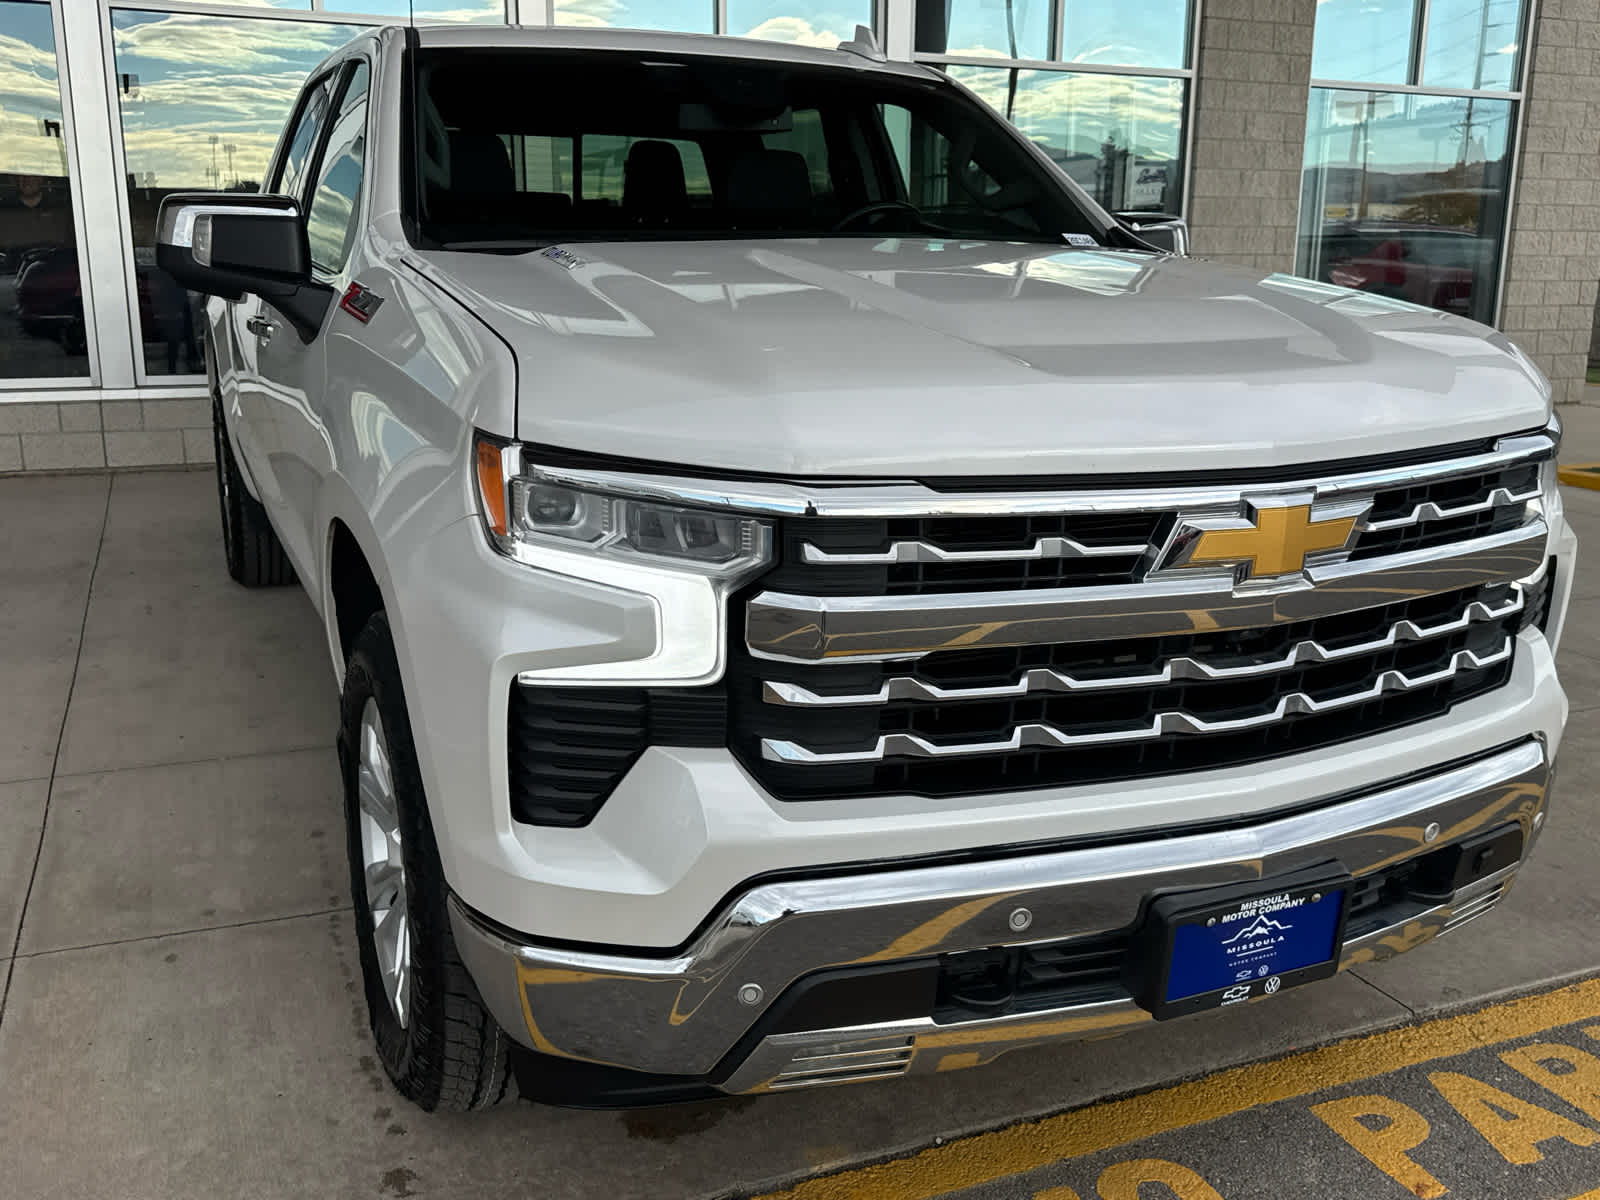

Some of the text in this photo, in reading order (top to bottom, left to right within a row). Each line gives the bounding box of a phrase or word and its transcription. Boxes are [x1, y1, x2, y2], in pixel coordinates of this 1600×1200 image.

[1222, 897, 1305, 924] MOTOR COMPANY
[1240, 893, 1290, 911] MISSOULA
[1226, 935, 1285, 954] MISSOULA
[1309, 1025, 1600, 1199] PAR
